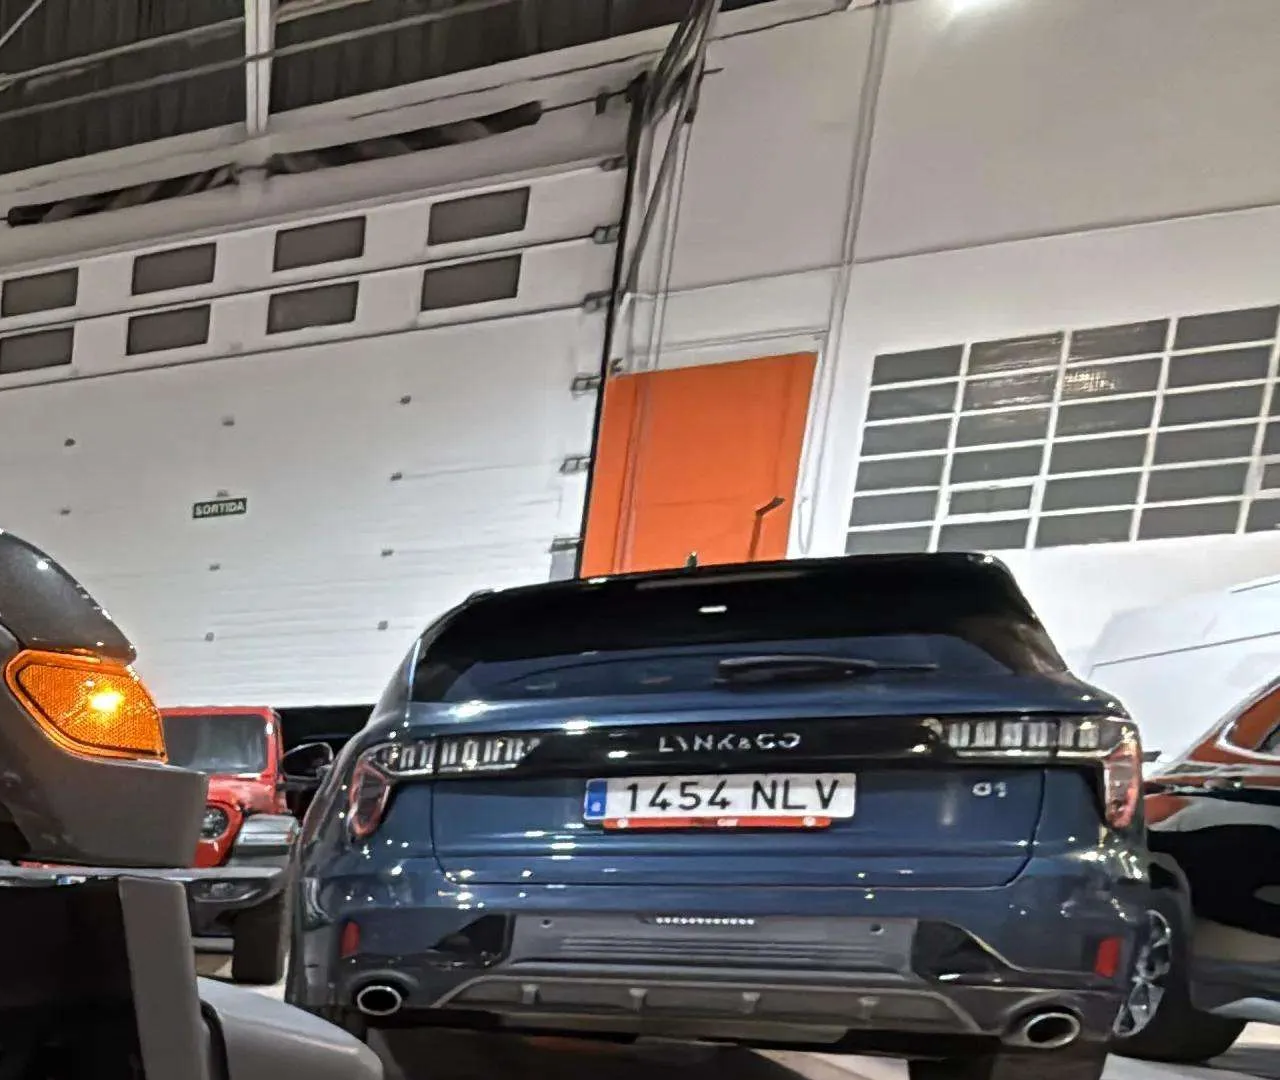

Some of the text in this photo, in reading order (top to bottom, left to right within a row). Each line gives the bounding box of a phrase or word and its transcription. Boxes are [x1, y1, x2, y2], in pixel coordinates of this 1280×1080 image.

[194, 500, 245, 516] SORTIDA
[627, 779, 839, 811] 1454 NLV
